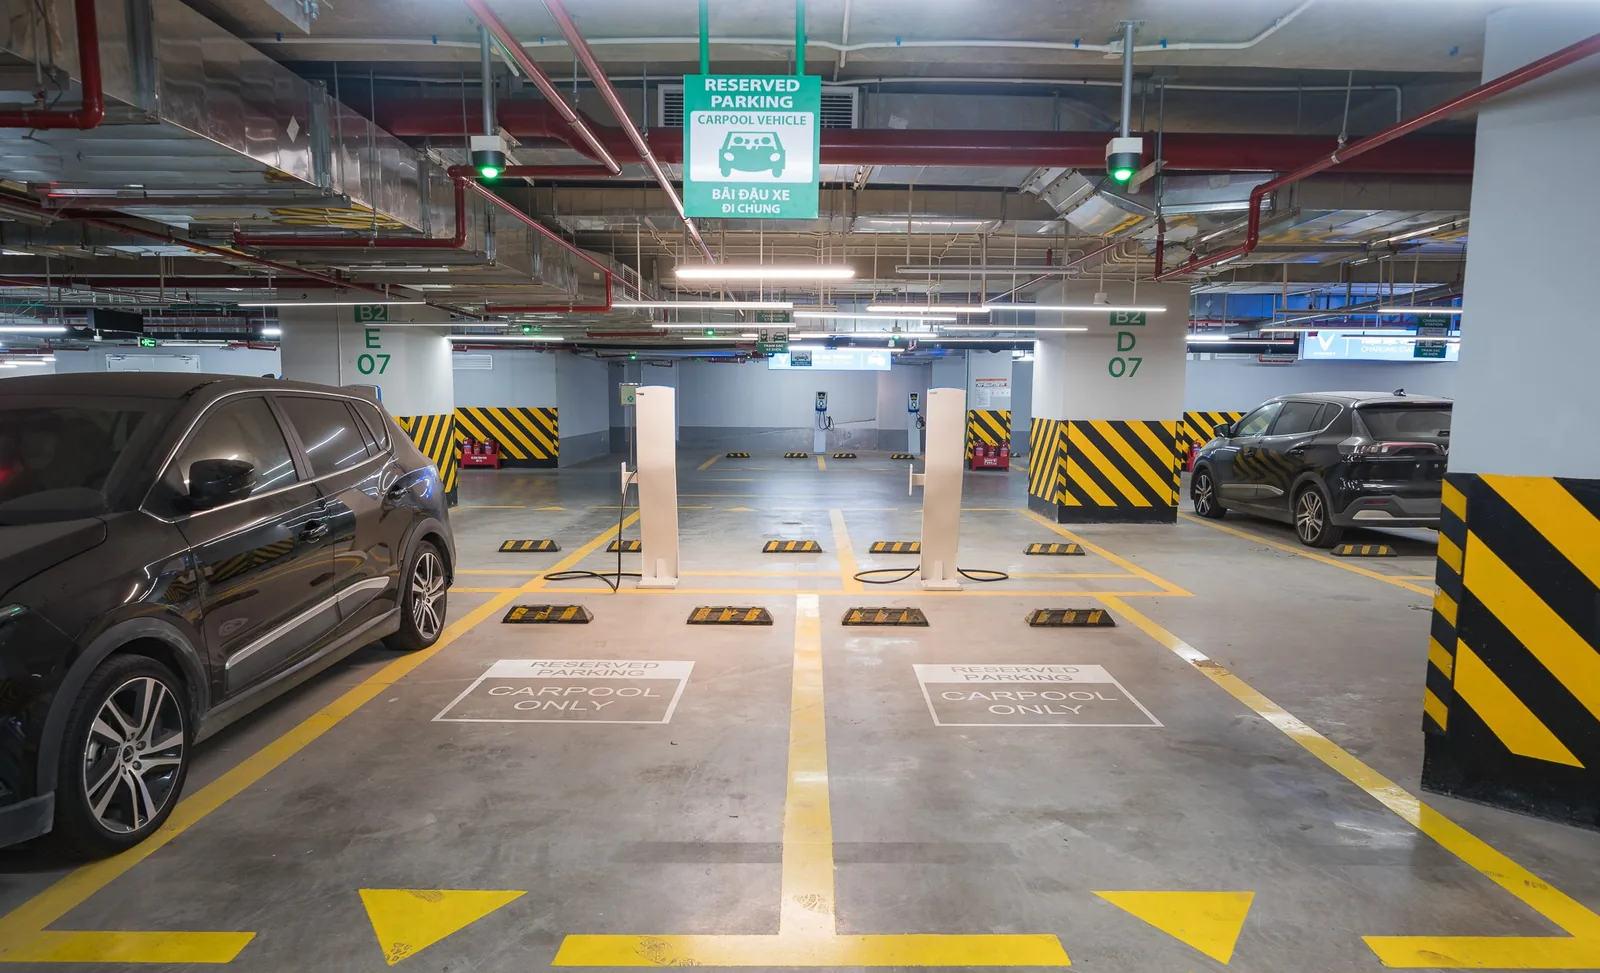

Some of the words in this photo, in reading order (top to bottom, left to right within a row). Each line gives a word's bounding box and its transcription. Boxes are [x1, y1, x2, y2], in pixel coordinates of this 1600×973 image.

[704, 78, 800, 92] RESERVED
[711, 95, 793, 108] PARKING
[697, 114, 755, 125] CARPOOL
[757, 115, 807, 125] VEHICLE
[712, 186, 735, 200] BÃI
[738, 187, 769, 203] ĐẬU
[772, 189, 790, 200] XE
[722, 203, 735, 213] ĐI
[737, 203, 781, 214] CHUNG
[360, 304, 386, 320] B2
[1115, 310, 1141, 323] B2
[365, 328, 381, 349] E
[1117, 331, 1136, 352] D
[357, 353, 391, 375] 07
[1108, 356, 1143, 378] 07
[530, 661, 660, 669] RESERVED
[536, 669, 645, 677] PARKING
[488, 686, 661, 698] CARPOOL
[941, 691, 1118, 701] CARPOOL
[513, 700, 616, 711] ONLY
[988, 704, 1083, 715] ONLY
